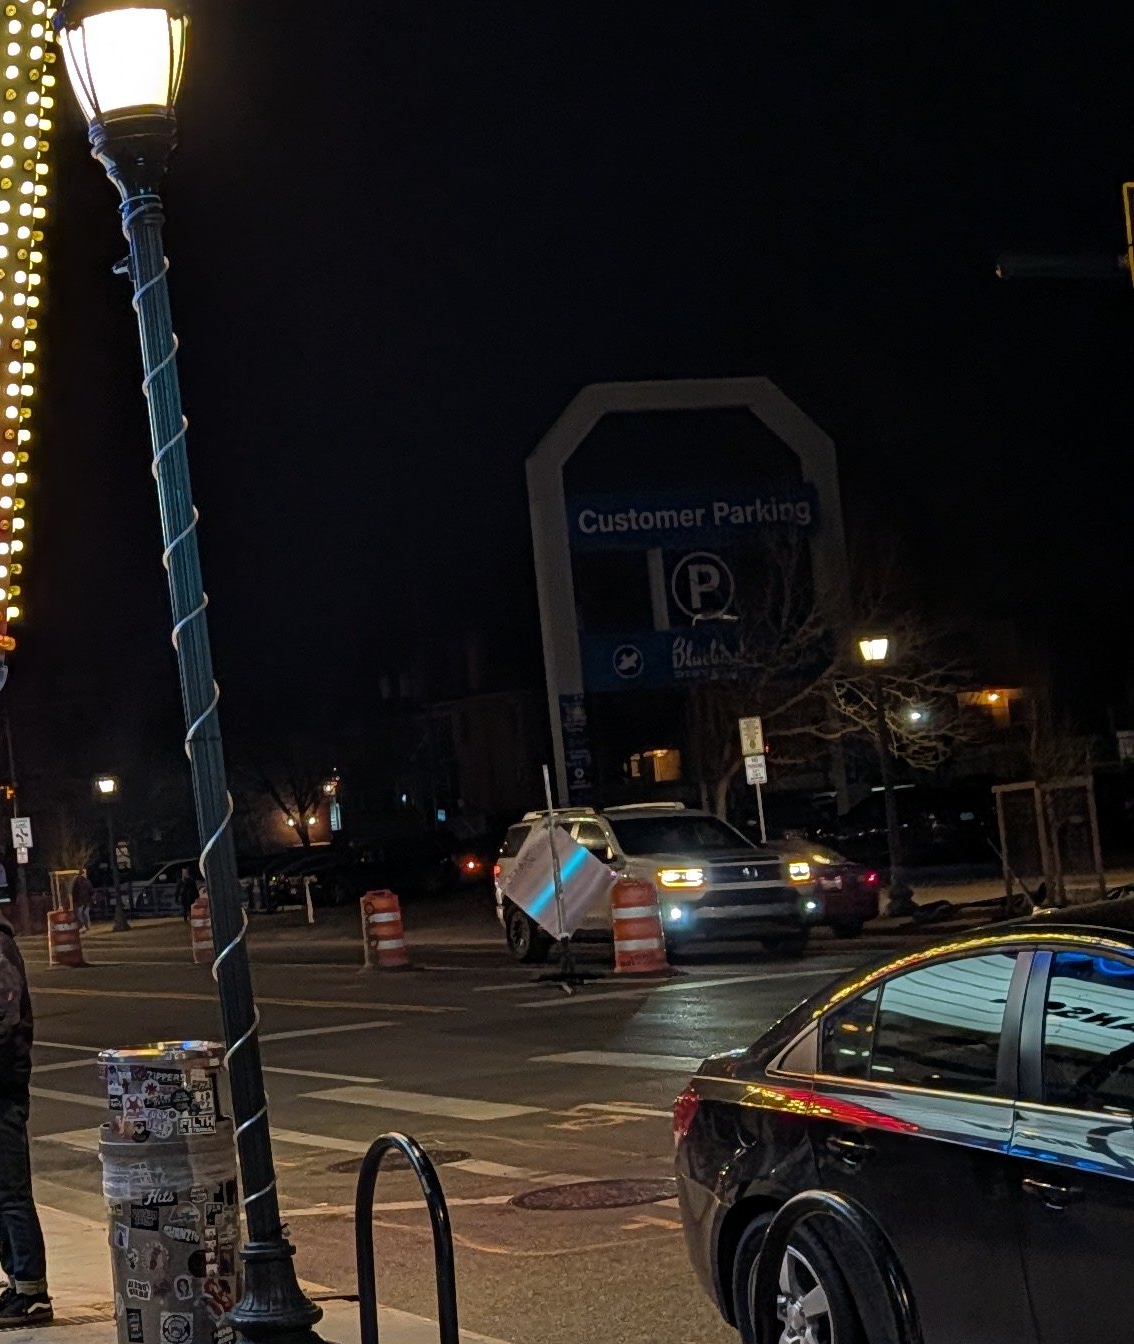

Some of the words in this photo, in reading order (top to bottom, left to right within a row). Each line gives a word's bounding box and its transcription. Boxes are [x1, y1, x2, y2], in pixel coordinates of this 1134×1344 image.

[578, 506, 706, 534] Customer
[712, 496, 812, 527] Parking
[144, 1188, 175, 1205] Hits
